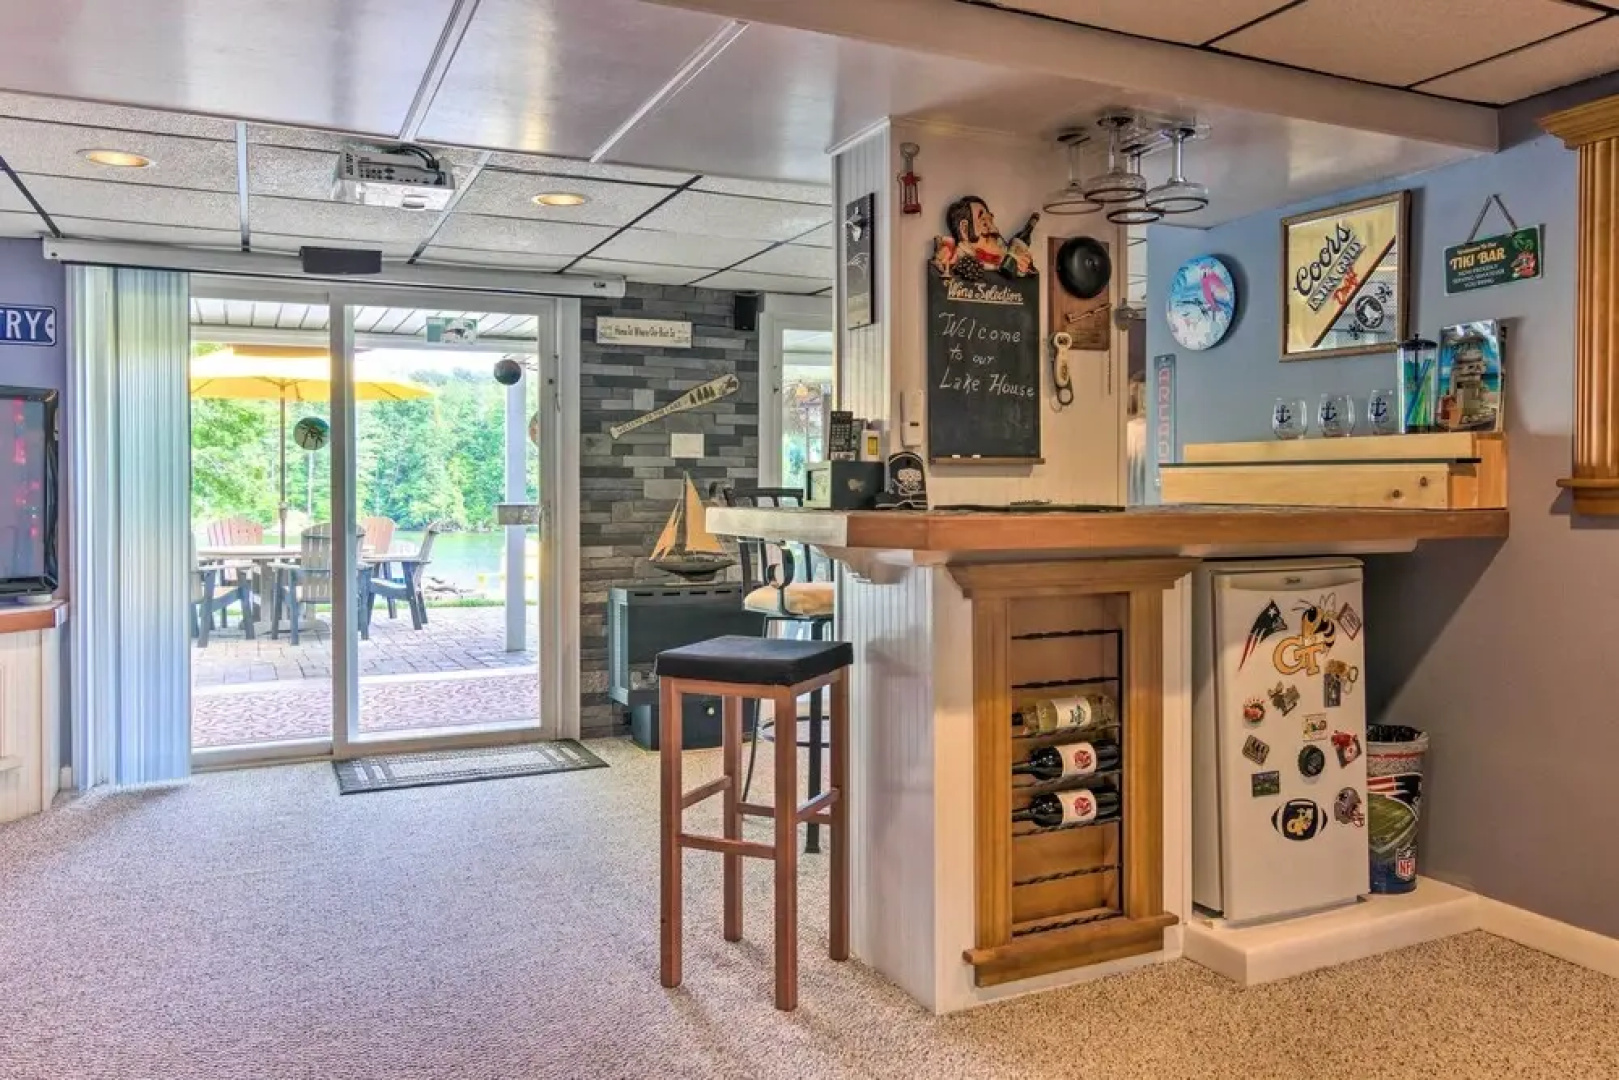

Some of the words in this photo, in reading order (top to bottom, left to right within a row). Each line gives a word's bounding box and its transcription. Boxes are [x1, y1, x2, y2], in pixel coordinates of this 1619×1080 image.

[1293, 223, 1351, 296] Coors
[1449, 254, 1475, 270] TIKI
[1477, 247, 1506, 264] BAR
[939, 312, 1021, 342] Welcome
[950, 343, 963, 361] to
[972, 355, 995, 365] our
[939, 366, 980, 395] Lake
[988, 373, 1035, 397] House
